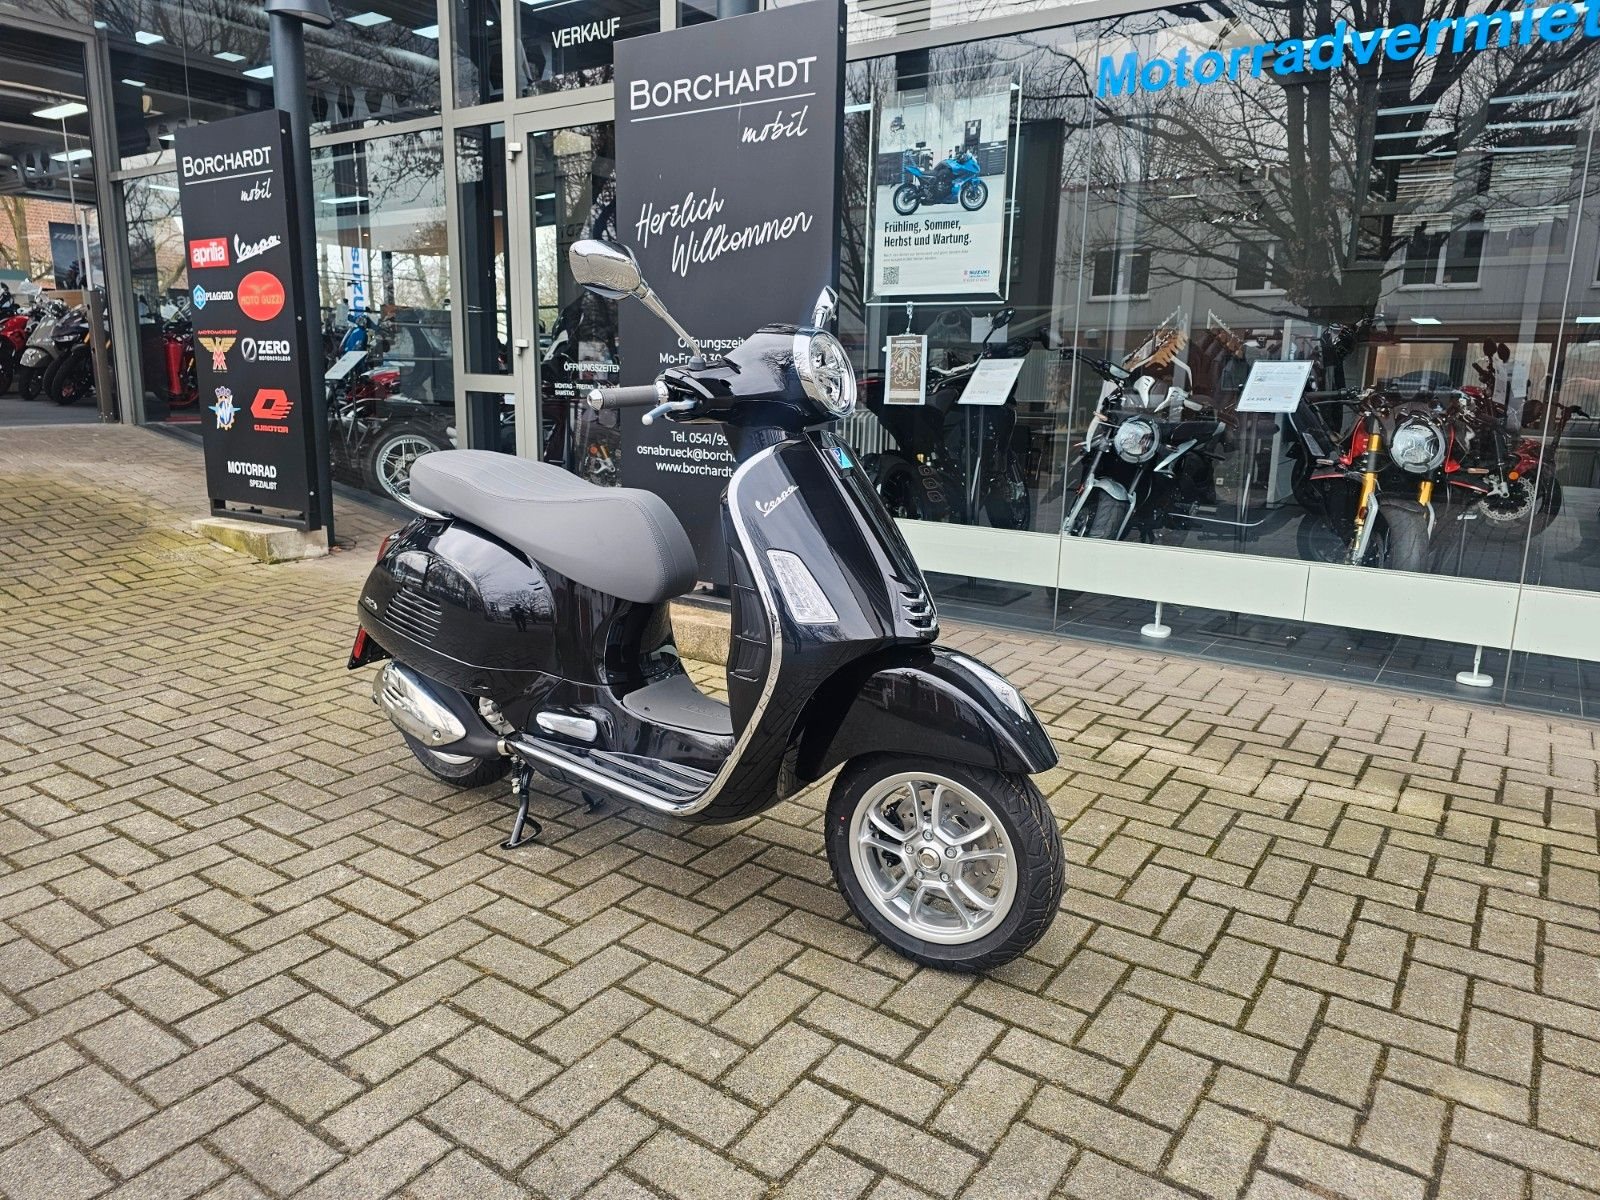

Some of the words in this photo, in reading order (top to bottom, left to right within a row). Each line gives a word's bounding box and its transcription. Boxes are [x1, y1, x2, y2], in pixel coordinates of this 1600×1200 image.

[551, 16, 621, 49] VERKAUF
[1096, 0, 1600, 99] Motorradvermiet
[630, 56, 817, 111] BORCHARDT
[741, 105, 809, 143] mobil
[182, 146, 272, 178] BORCHARDT
[240, 177, 272, 202] mobil
[635, 187, 725, 249] Herzlich
[884, 220, 922, 234] Frühling,
[924, 219, 962, 231] Sommer,
[233, 233, 281, 264] Vespa
[671, 211, 813, 278] Willkommen
[884, 235, 912, 248] Herbst
[914, 235, 931, 247] und
[932, 232, 972, 246] Wartung.
[193, 241, 226, 268] aprilia
[205, 290, 235, 301] PIAGGIO
[241, 295, 260, 306] MOTO
[261, 293, 283, 306] GUZZI
[257, 339, 291, 355] ZERO
[677, 335, 745, 351] Önungszeit
[670, 430, 688, 442] Tel.
[227, 460, 278, 479] MOTORRAD
[249, 479, 278, 490] SPEZIALIST
[754, 484, 800, 518] Vespa
